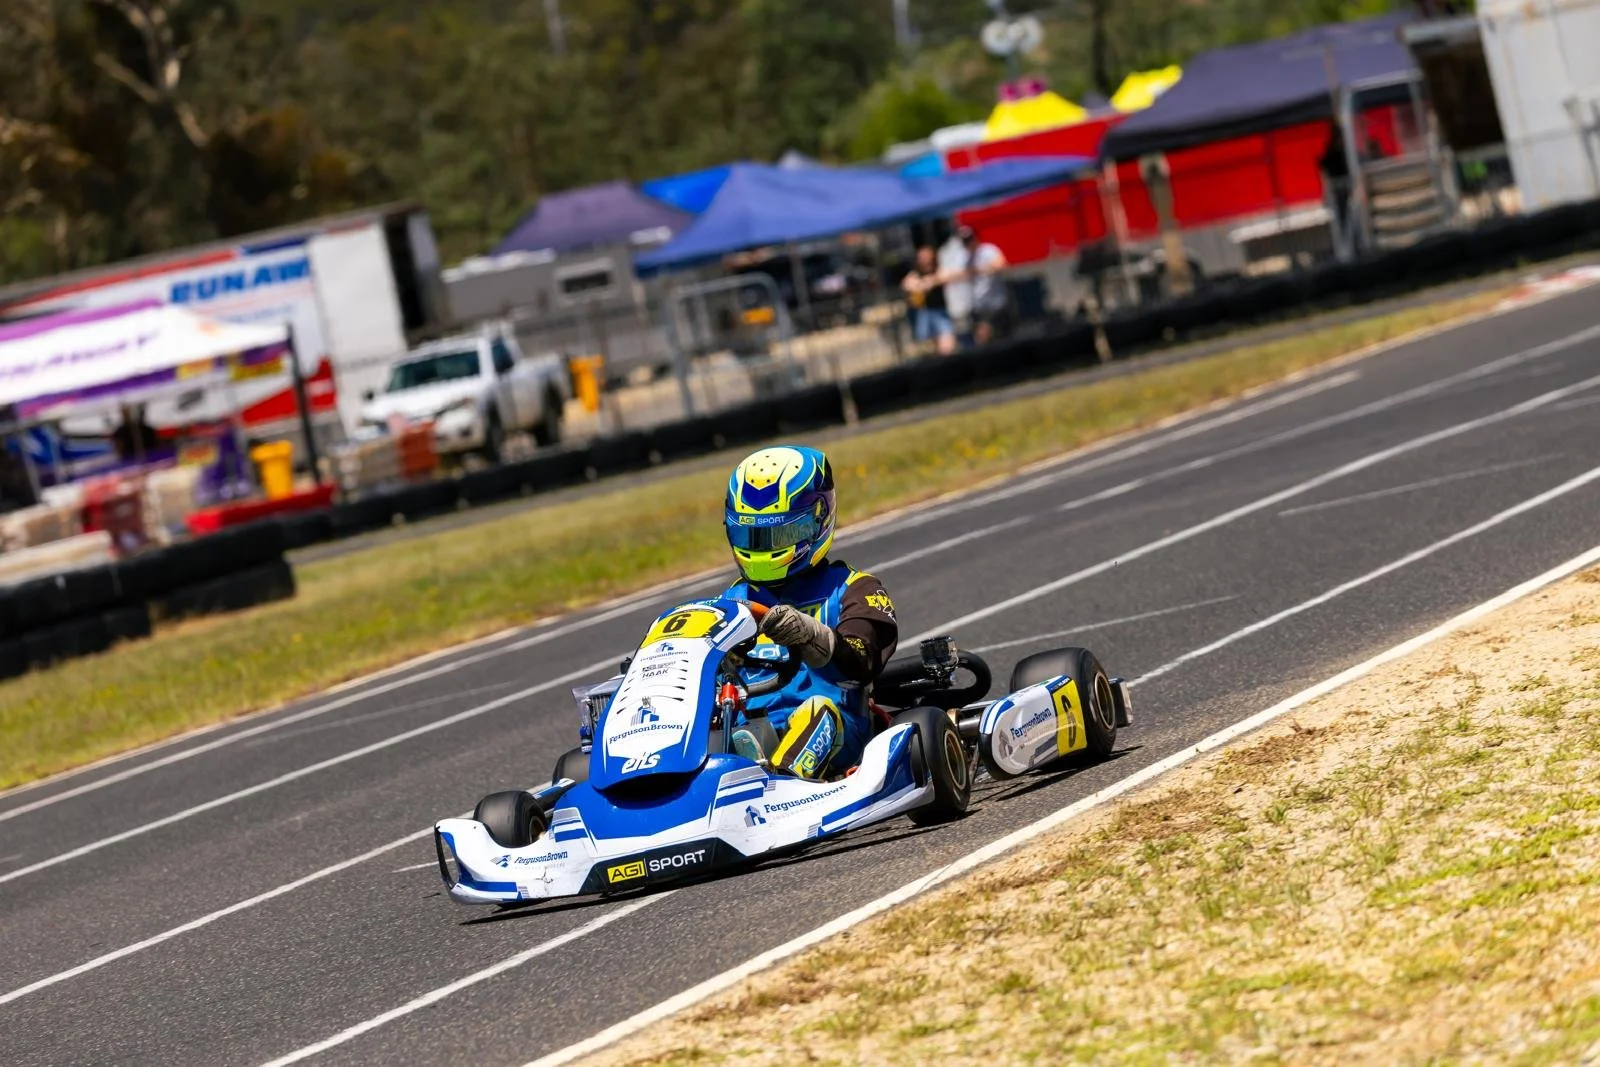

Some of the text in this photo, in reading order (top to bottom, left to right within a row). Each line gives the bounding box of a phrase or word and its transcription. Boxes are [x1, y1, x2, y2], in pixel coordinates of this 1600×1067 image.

[757, 516, 786, 525] SPORT
[661, 613, 691, 634] 6
[609, 724, 683, 744] FergusonBrown
[764, 784, 847, 813] FergusonBrown
[514, 850, 568, 865] FergusonBrown
[610, 849, 706, 881] AGI SPORT
